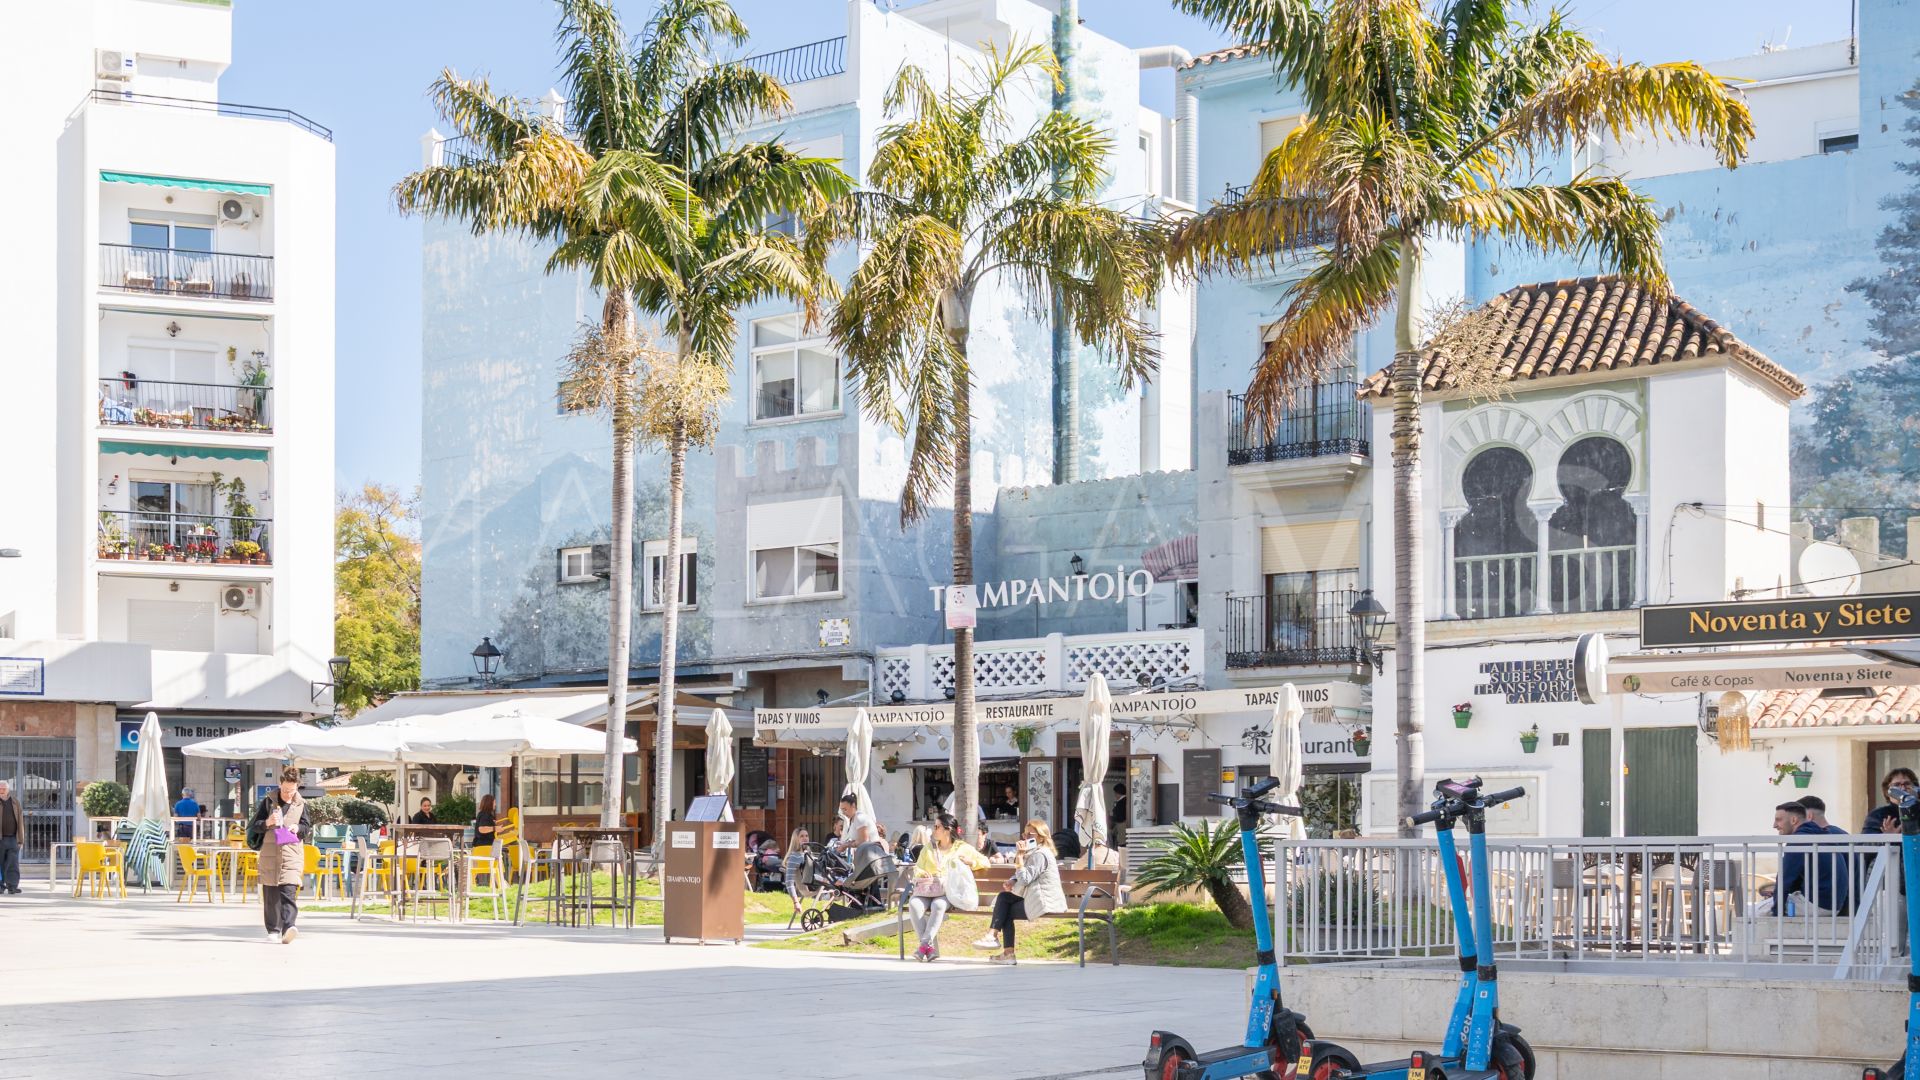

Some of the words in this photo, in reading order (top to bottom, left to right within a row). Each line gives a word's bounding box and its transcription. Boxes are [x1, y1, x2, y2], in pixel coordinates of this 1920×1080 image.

[929, 565, 1154, 611] TMPANTOjO
[1689, 609, 1807, 634] Noventa
[1812, 611, 1831, 635] y
[1838, 603, 1911, 627] Siete
[1671, 675, 1700, 687] Café
[1702, 676, 1711, 687] &
[1714, 675, 1754, 689] Copas
[1785, 670, 1844, 683] Noventa
[1846, 672, 1854, 684] y
[1857, 668, 1892, 681] Siete
[758, 713, 784, 725] TAPAS
[786, 713, 792, 723] Y
[795, 712, 820, 724] VINOS
[868, 707, 945, 723] AMPANTOjO
[986, 703, 1054, 719] RESTAURANTE
[1110, 695, 1197, 713] AMPANTOjO
[1245, 691, 1279, 706] TAPAS
[174, 726, 193, 738] The
[195, 726, 225, 738] Black
[1557, 734, 1564, 744] 7
